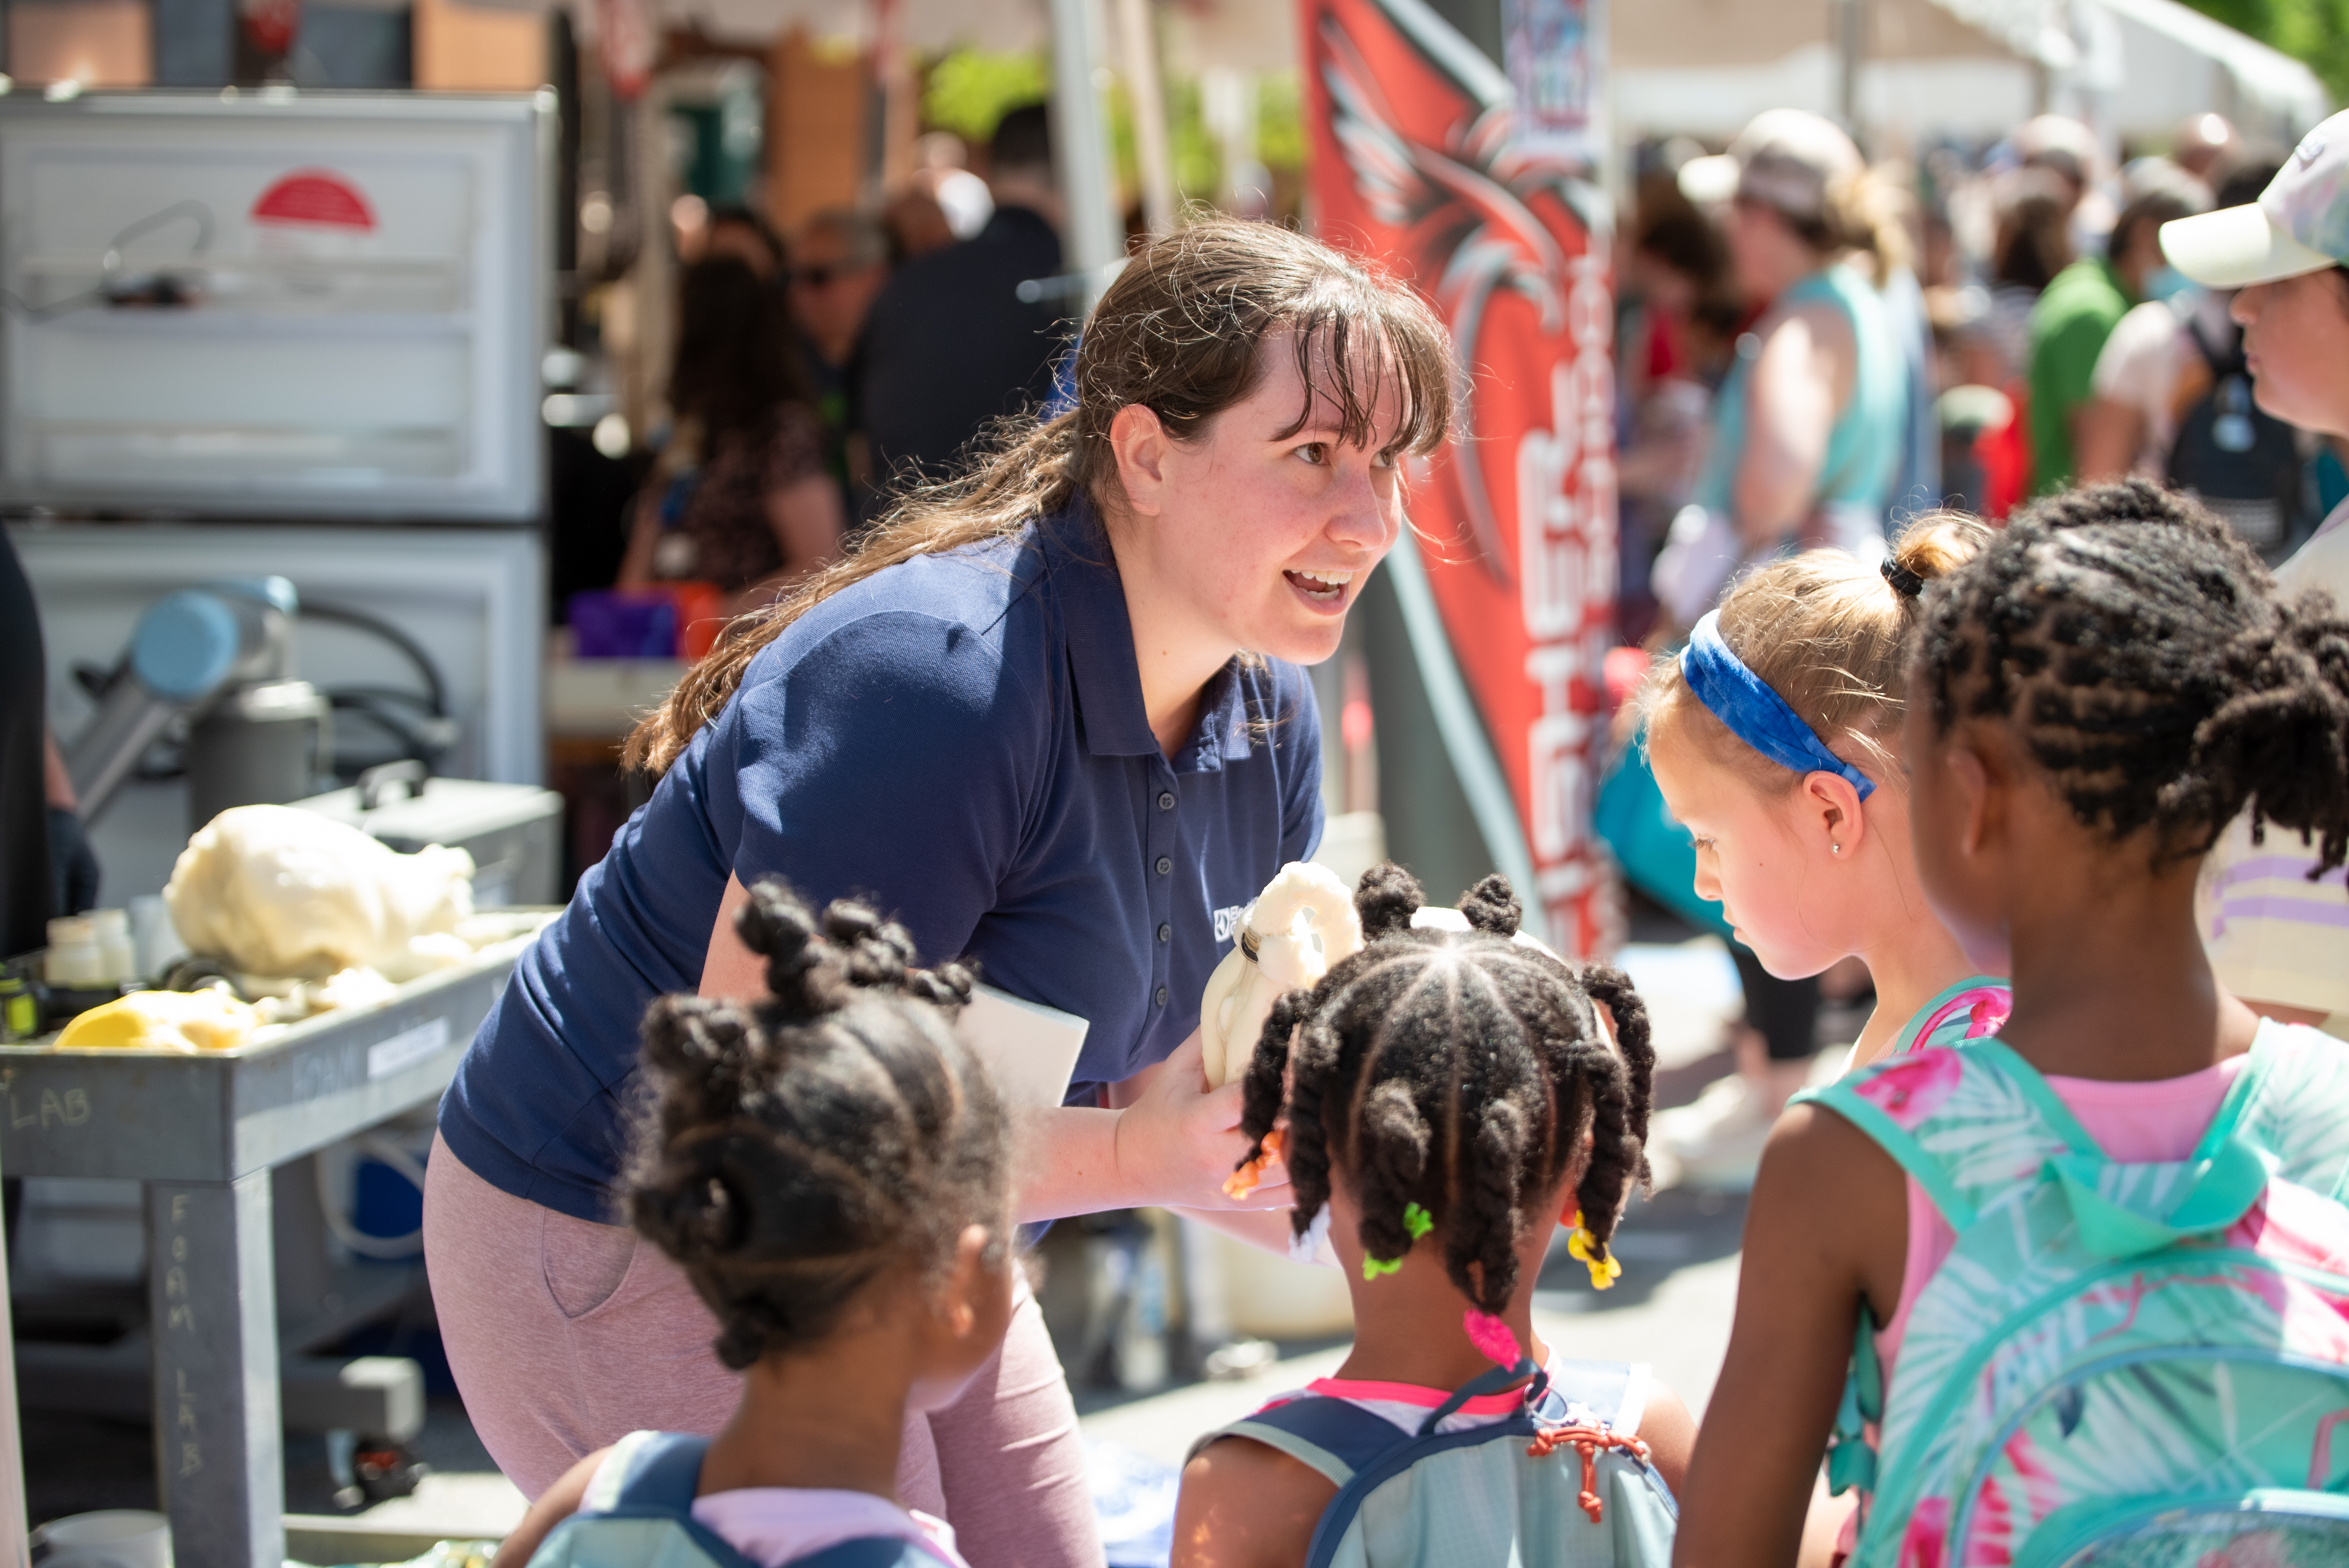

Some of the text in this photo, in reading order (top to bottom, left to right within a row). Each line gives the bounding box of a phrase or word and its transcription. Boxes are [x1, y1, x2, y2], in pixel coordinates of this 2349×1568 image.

[10, 1087, 92, 1131] LAB
[166, 1194, 205, 1477] FOAM LAB
